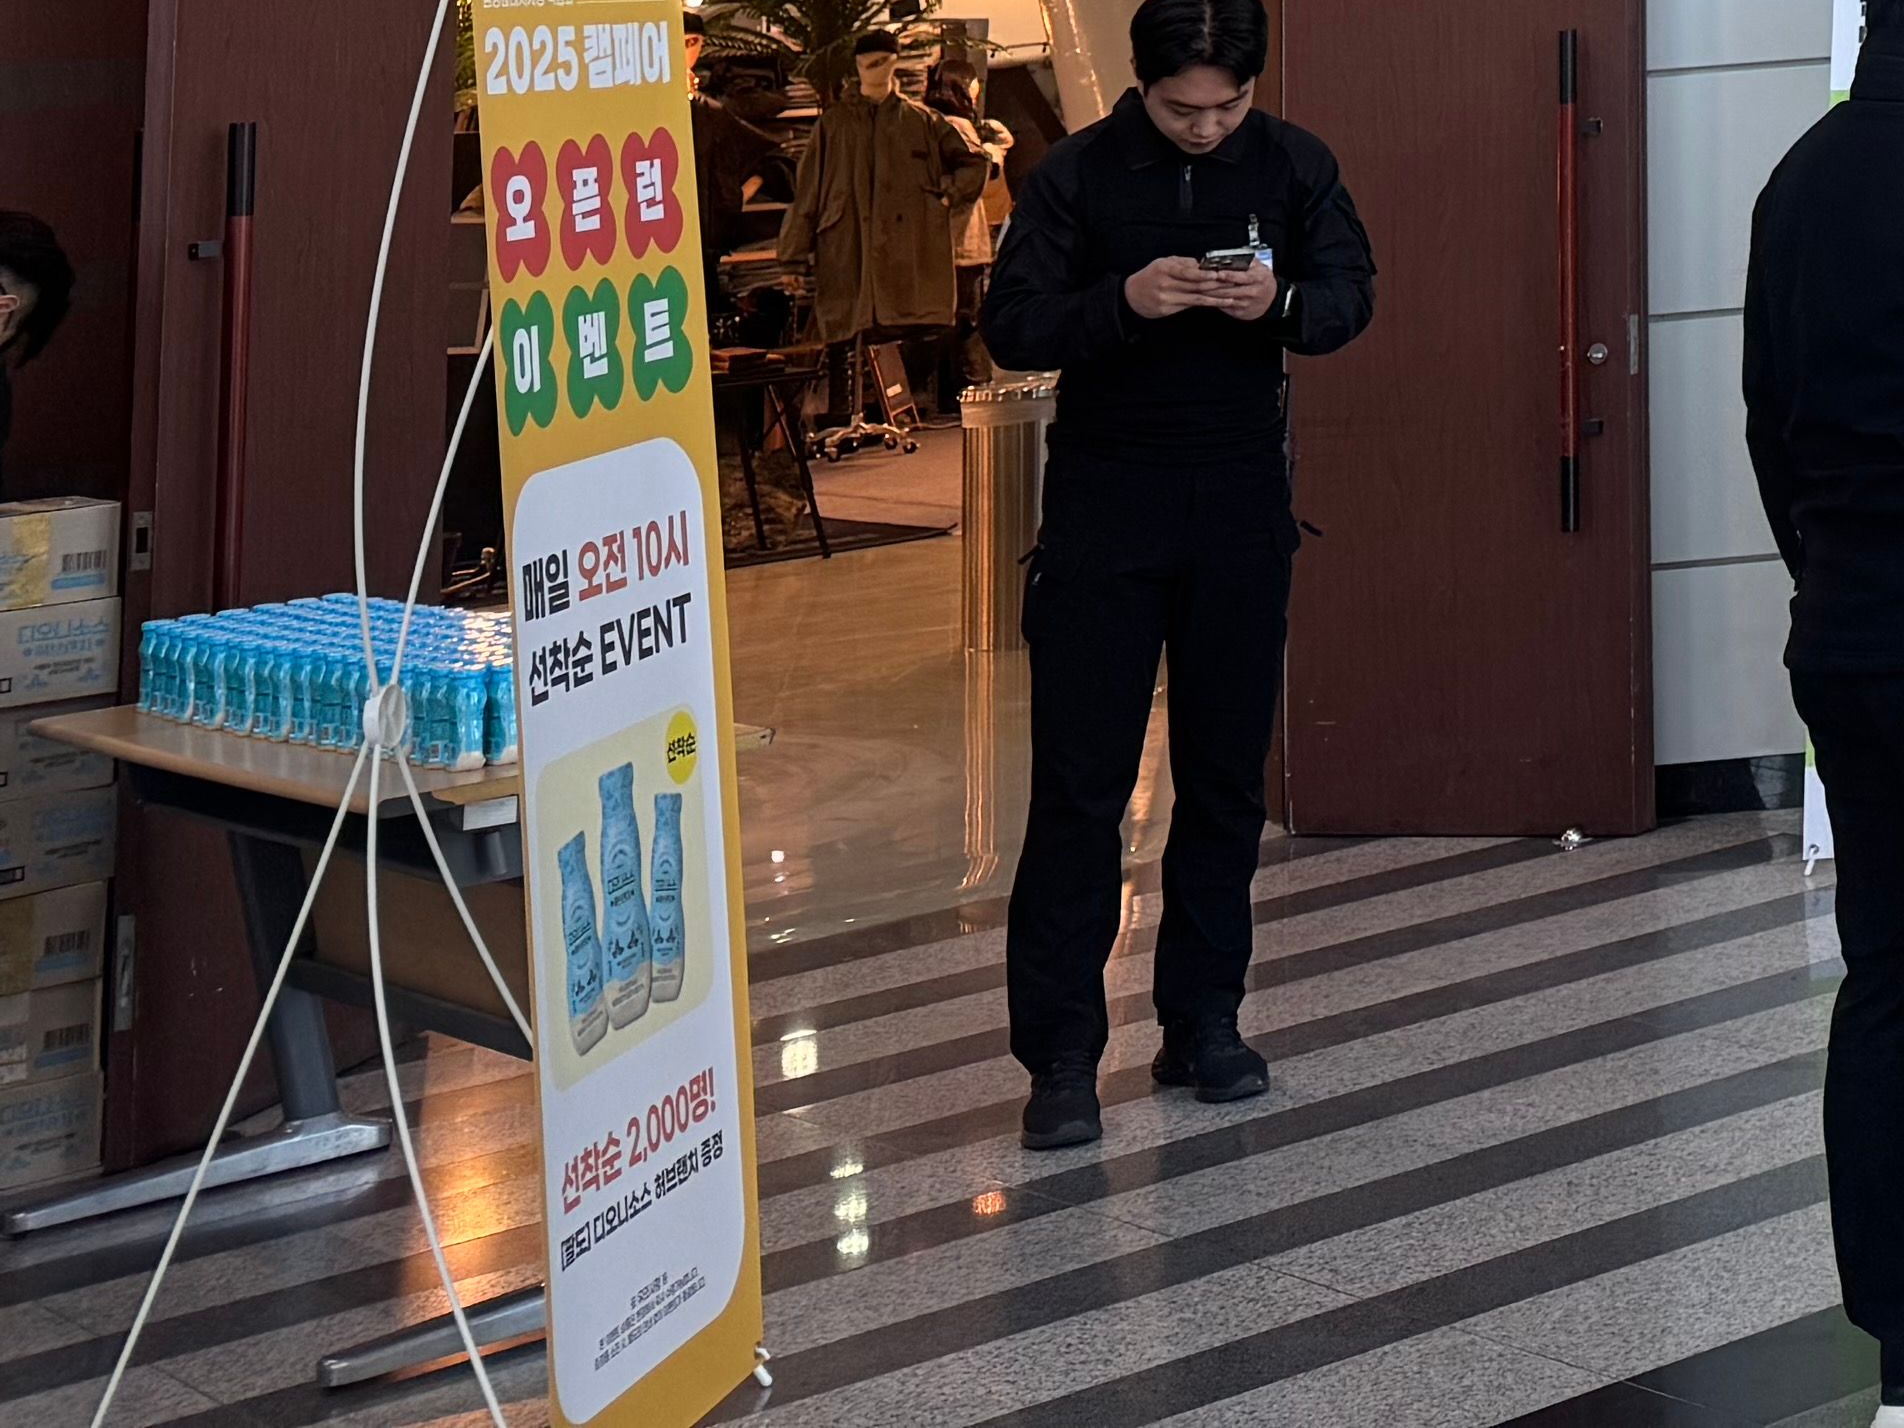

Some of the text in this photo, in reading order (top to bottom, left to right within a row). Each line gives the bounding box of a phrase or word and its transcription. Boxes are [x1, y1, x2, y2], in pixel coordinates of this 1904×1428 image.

[484, 21, 671, 95] 2025 캠페어
[522, 510, 689, 622] 매일 오전 10시
[529, 592, 692, 707] 선착순 EVENT
[562, 1066, 717, 1215] 선착순 2,000명!
[594, 1181, 653, 1244] 디오니소스
[701, 1129, 724, 1168] 증정
